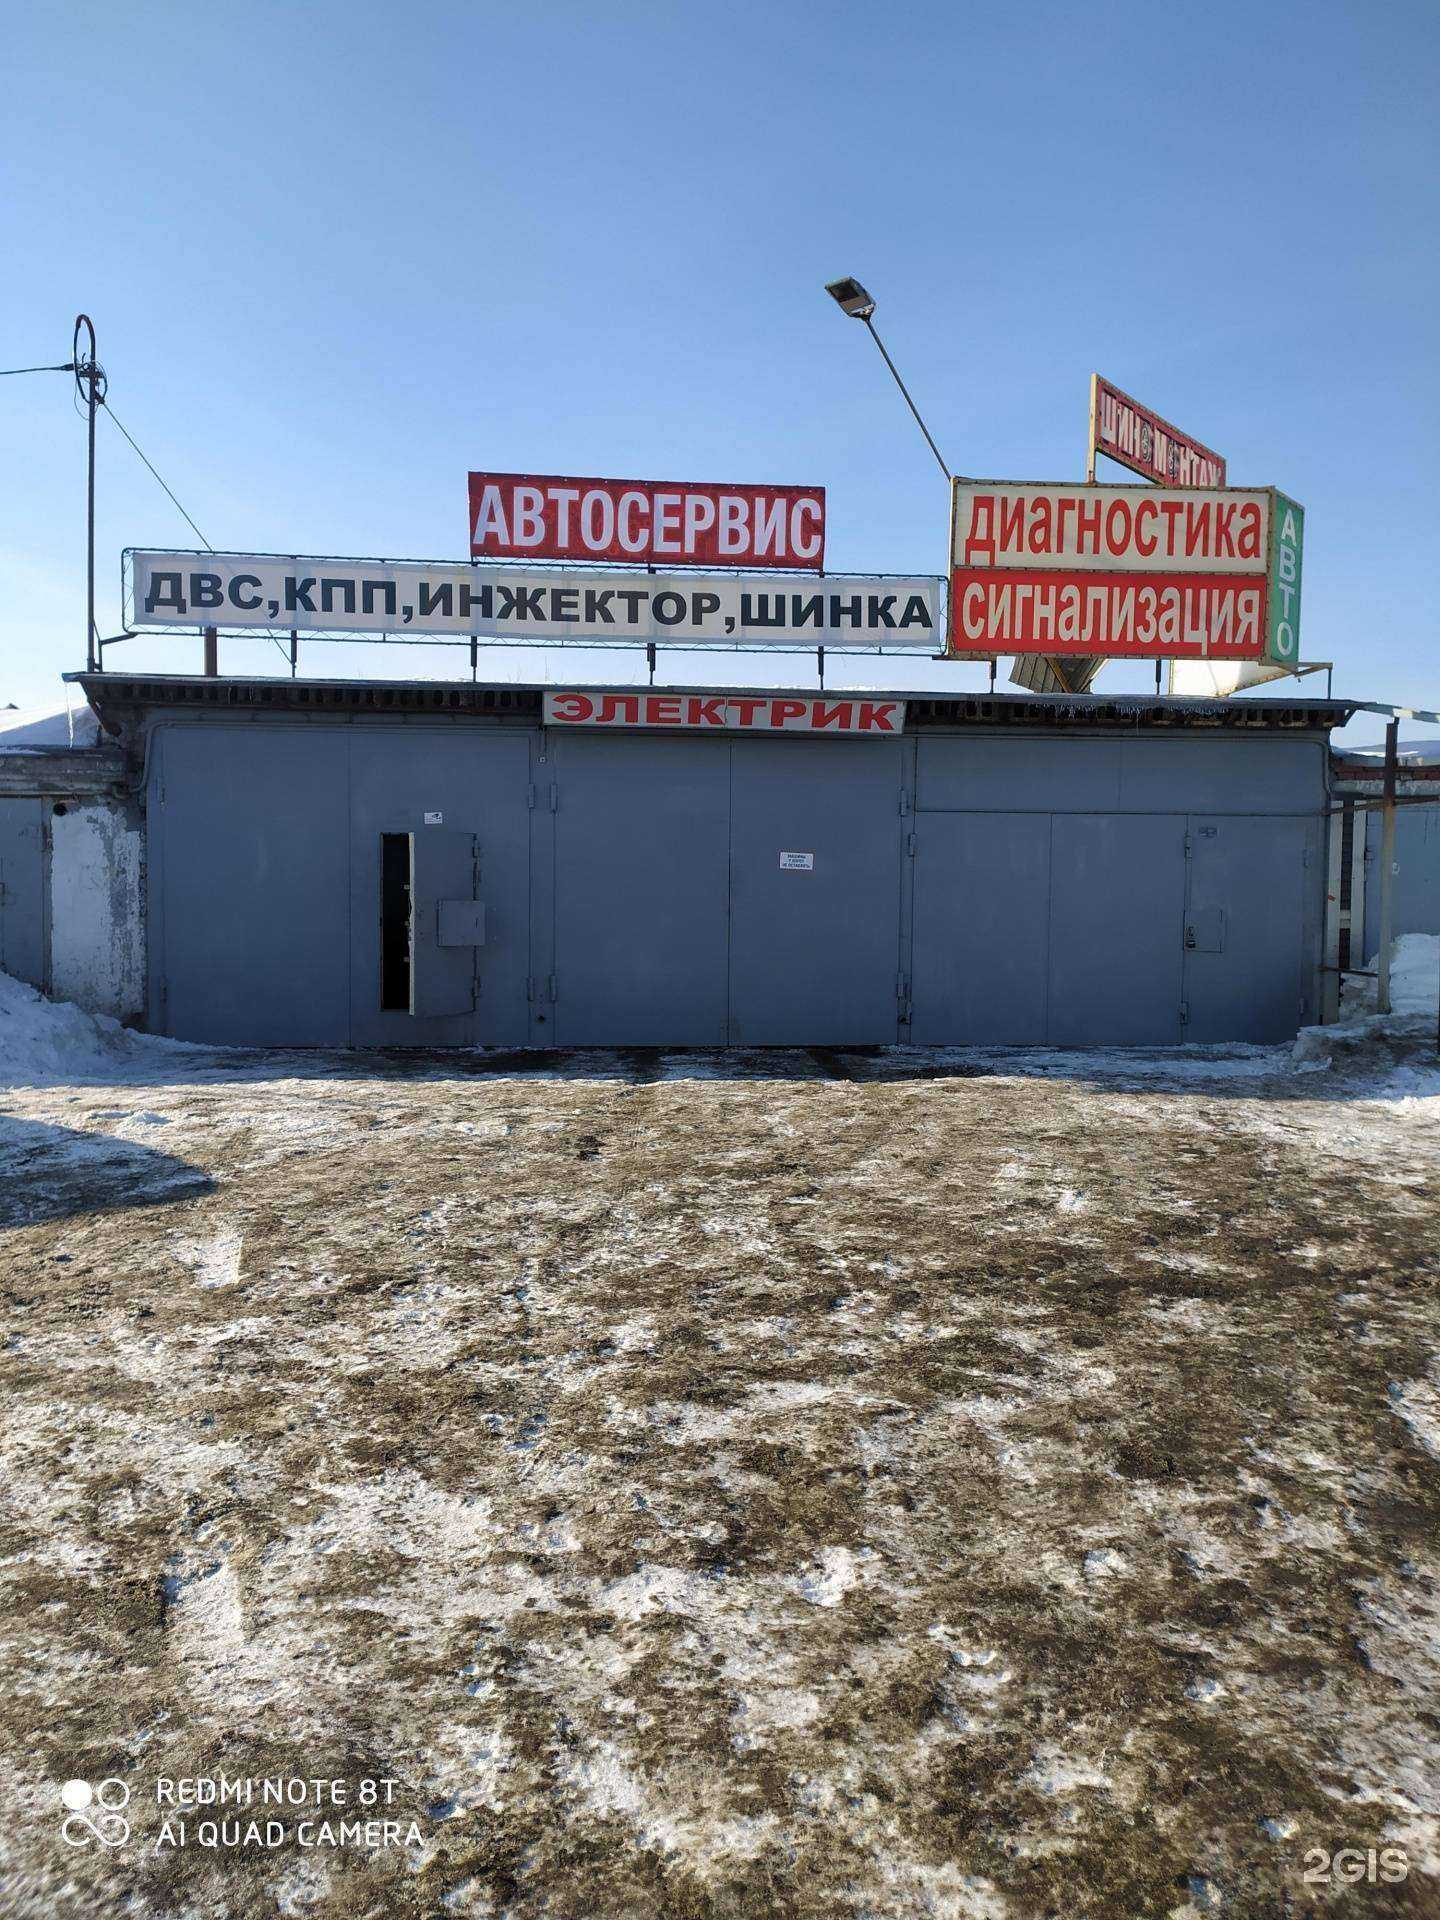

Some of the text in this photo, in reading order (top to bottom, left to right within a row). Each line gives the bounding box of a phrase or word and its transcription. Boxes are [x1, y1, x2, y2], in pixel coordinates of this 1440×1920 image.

[473, 485, 822, 559] АВТОСЕРВИС
[1276, 508, 1297, 656] АВТО
[551, 693, 896, 730] ЭЛЕКТРИК
